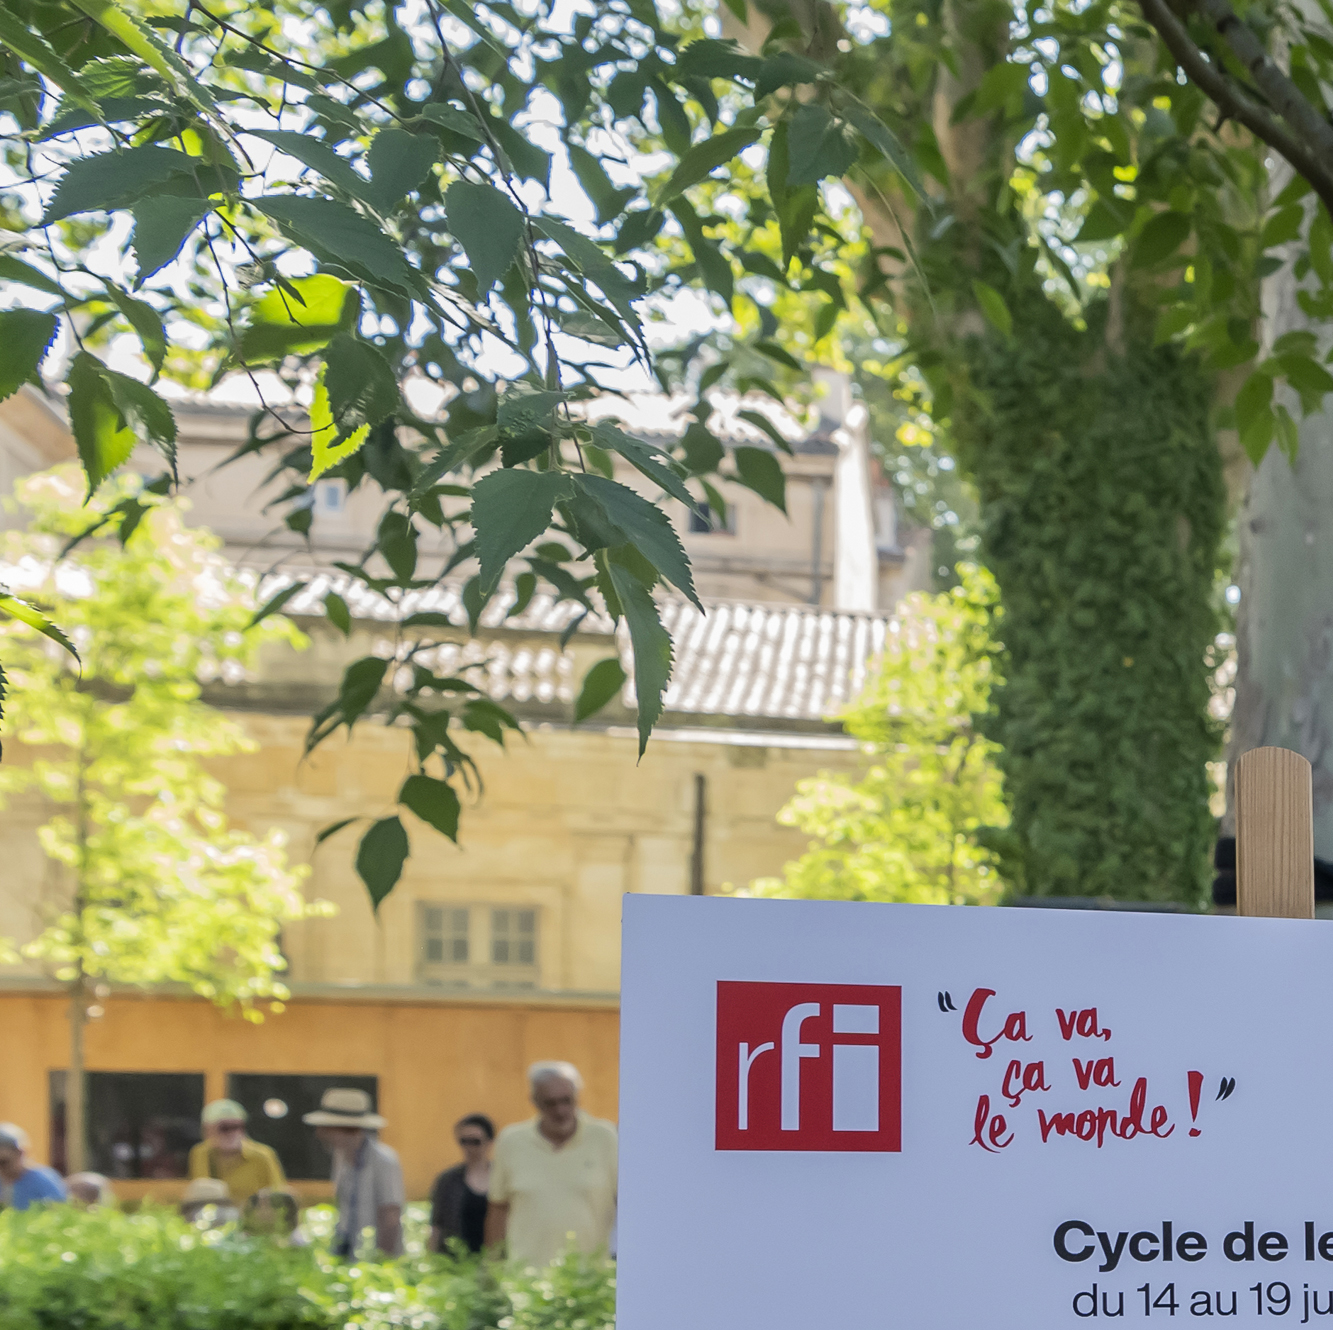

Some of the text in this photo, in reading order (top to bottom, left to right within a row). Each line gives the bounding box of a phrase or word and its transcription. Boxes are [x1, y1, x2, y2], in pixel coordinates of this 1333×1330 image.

[1055, 1007, 1112, 1042] va,
[738, 1002, 880, 1132] rfi
[1002, 1057, 1122, 1108] ça va
[968, 1094, 1015, 1154] le
[1037, 1077, 1175, 1149] monde
[1054, 1220, 1207, 1272] Cycle
[1223, 1221, 1288, 1261] de
[1073, 1283, 1123, 1317] du
[1137, 1283, 1179, 1316] 14
[1190, 1291, 1237, 1316] au
[1250, 1282, 1290, 1315] 19
